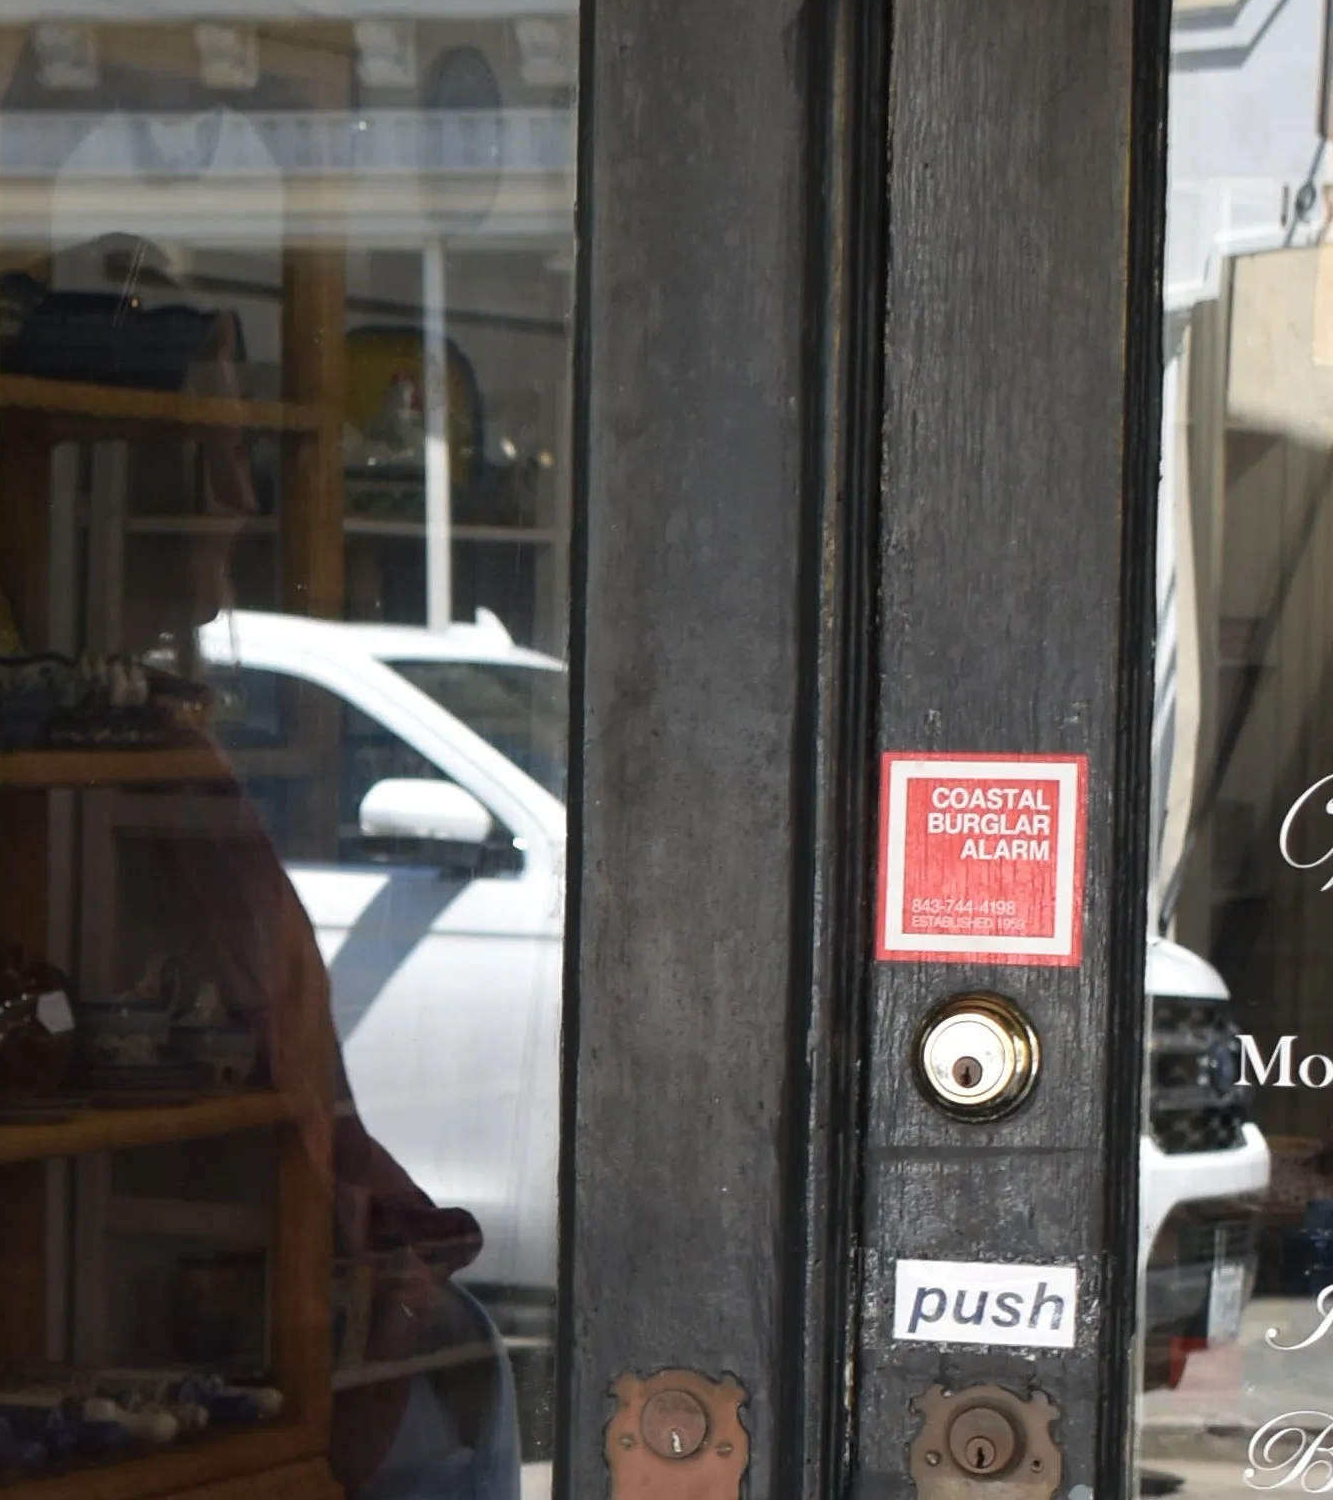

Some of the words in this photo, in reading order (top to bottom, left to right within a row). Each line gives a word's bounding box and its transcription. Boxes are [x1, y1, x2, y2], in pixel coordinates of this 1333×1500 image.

[932, 787, 1051, 810] COASTAL
[928, 812, 1050, 835] BURGLAR
[960, 839, 1049, 861] ALARM
[911, 899, 1016, 916] 843-744-4198
[911, 915, 994, 929] ESTABLISHED
[907, 1281, 1065, 1334] push
